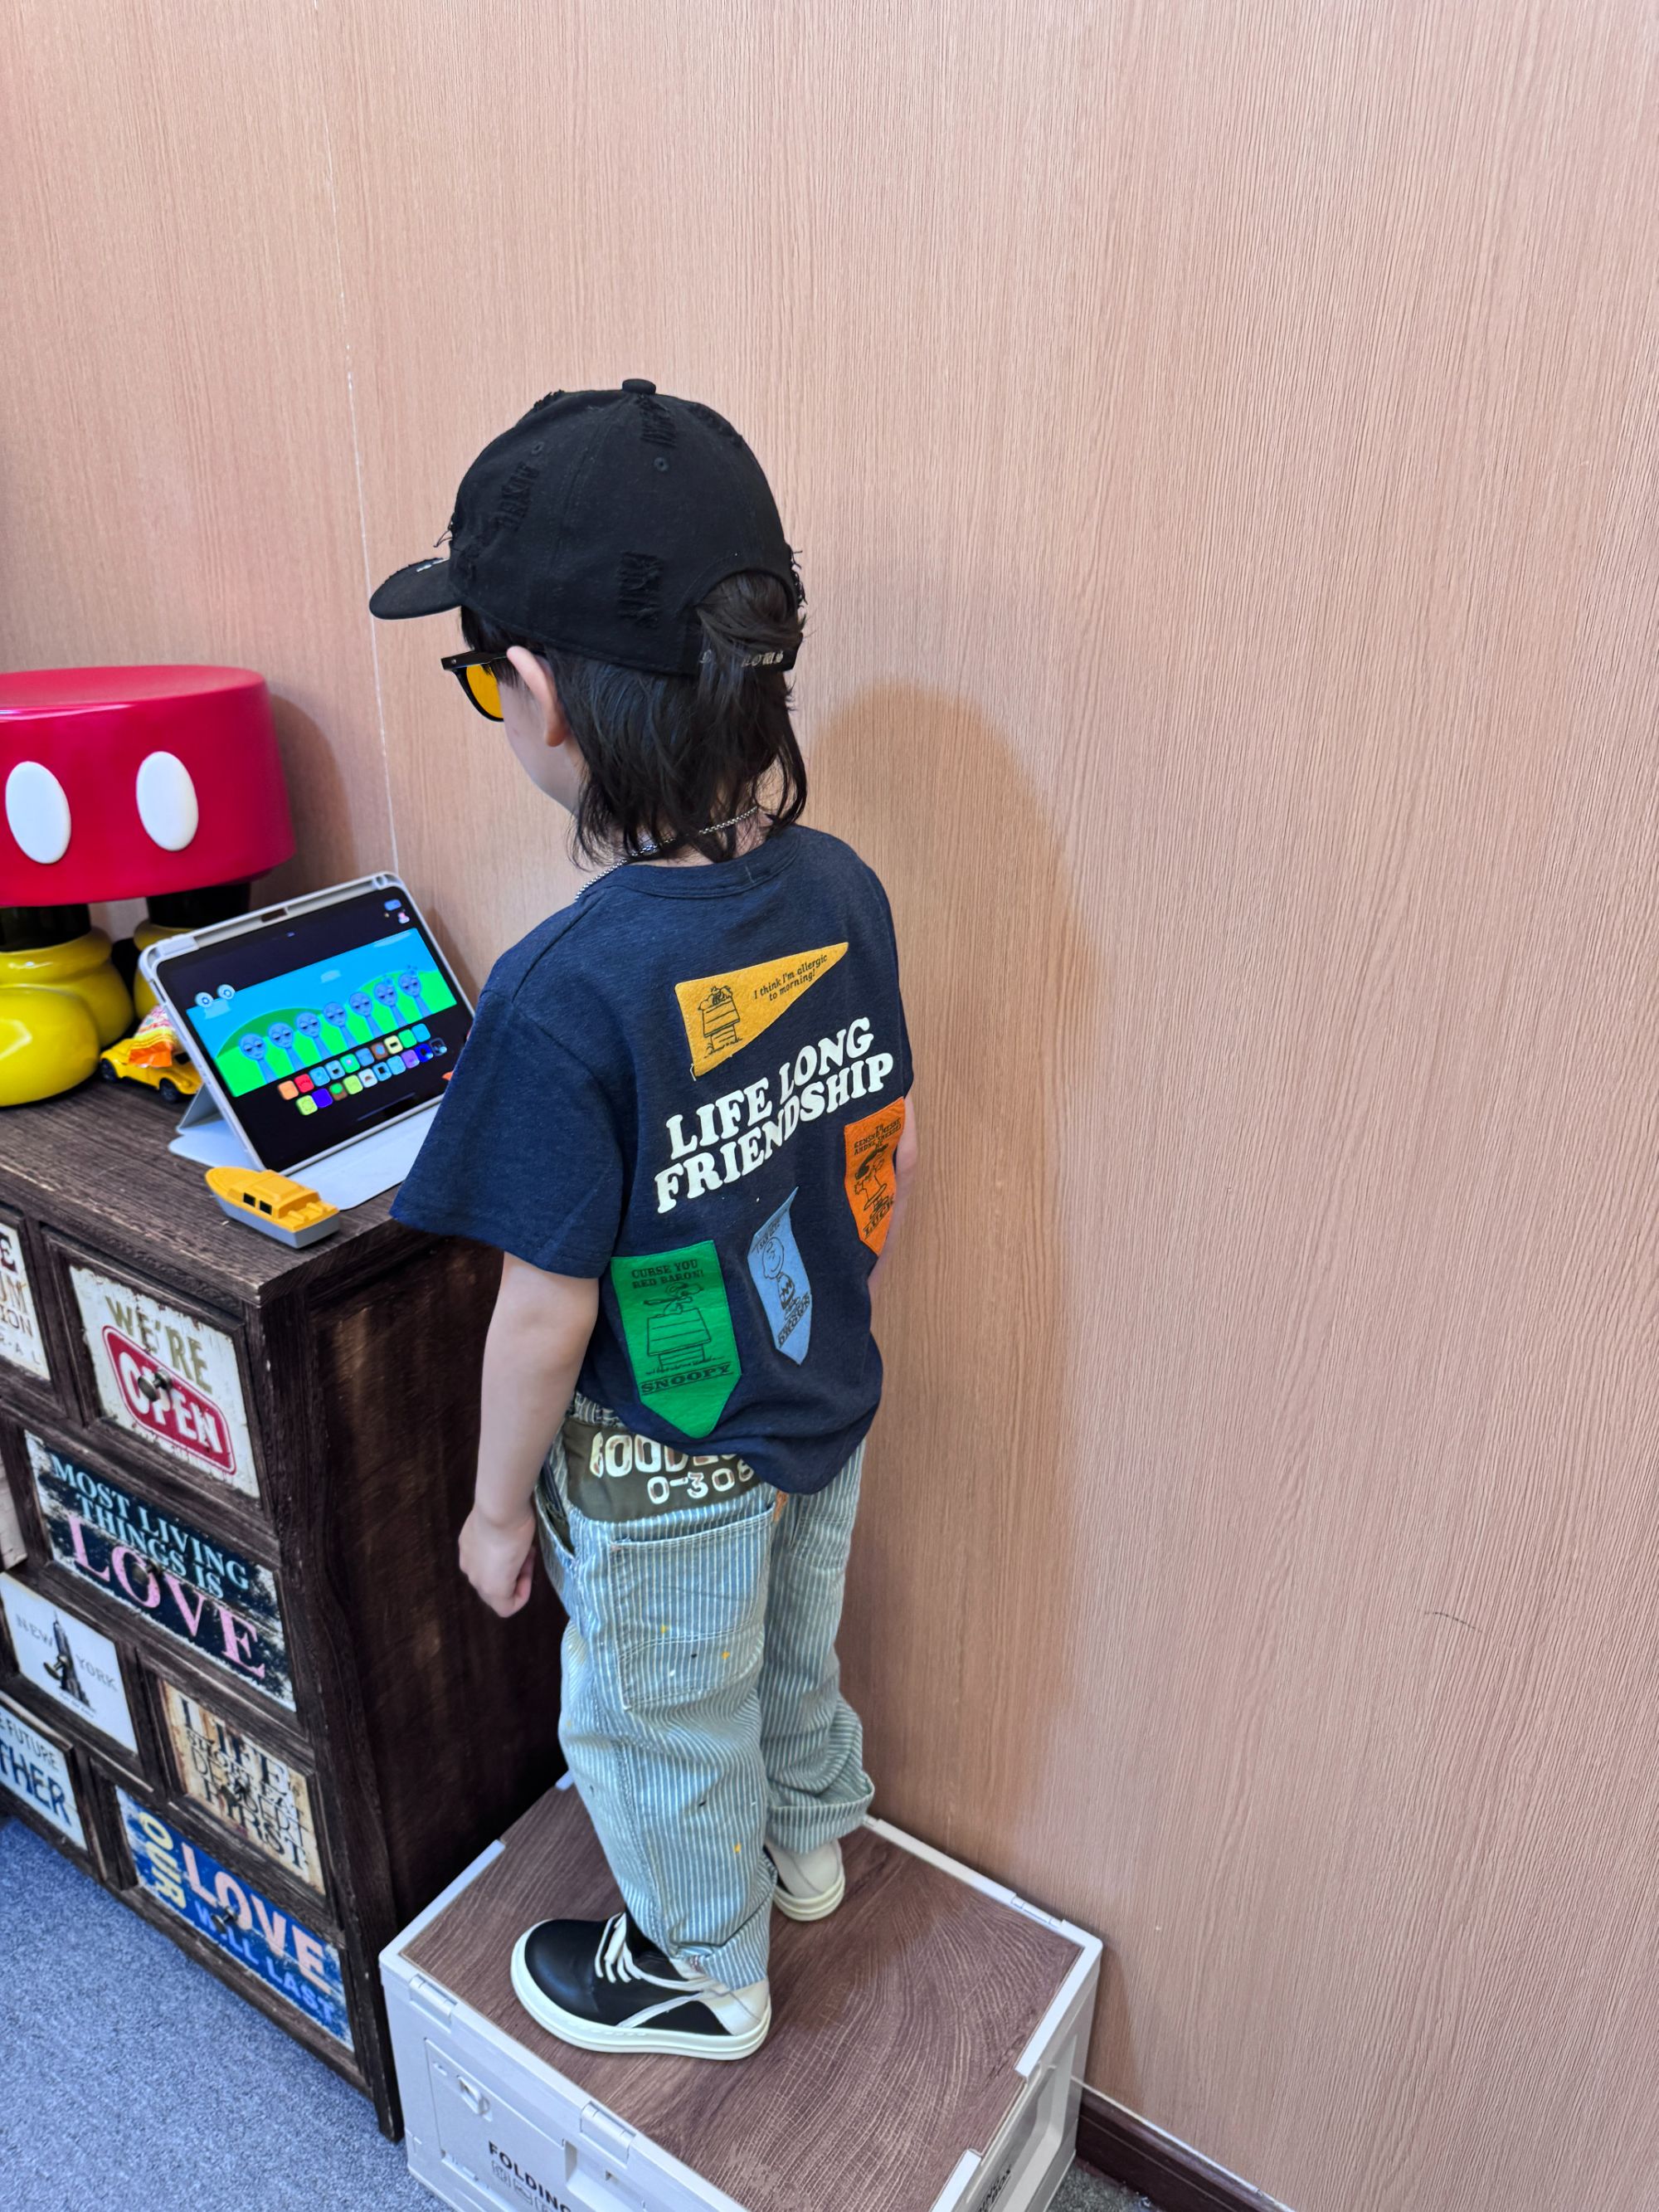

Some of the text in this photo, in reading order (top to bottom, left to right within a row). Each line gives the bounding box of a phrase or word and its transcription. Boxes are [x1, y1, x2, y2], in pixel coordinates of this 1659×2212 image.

[753, 954, 828, 1000] I think I'm allergic
[769, 968, 815, 1001] to morning!
[654, 1052, 894, 1214] FRIENDSHIP
[665, 1016, 874, 1161] LIFE LONG
[631, 1259, 699, 1279] CURSE YOU
[632, 1269, 704, 1289] RED BARON!
[105, 1295, 212, 1395] WE'RE
[641, 1363, 731, 1394] SNOOPY
[119, 1351, 223, 1454] OPEN
[51, 1454, 250, 1591] MOST LIVING
[75, 1493, 225, 1599] THINGS IS
[66, 1512, 266, 1679] LOVE
[16, 1613, 118, 1693] NEW YORK
[6, 1717, 59, 1773] FUTURE
[178, 1694, 288, 1797] LIFE
[139, 1812, 187, 1908] OUR
[182, 1842, 332, 1995] LOVE
[194, 1900, 335, 2024] WLL LAST
